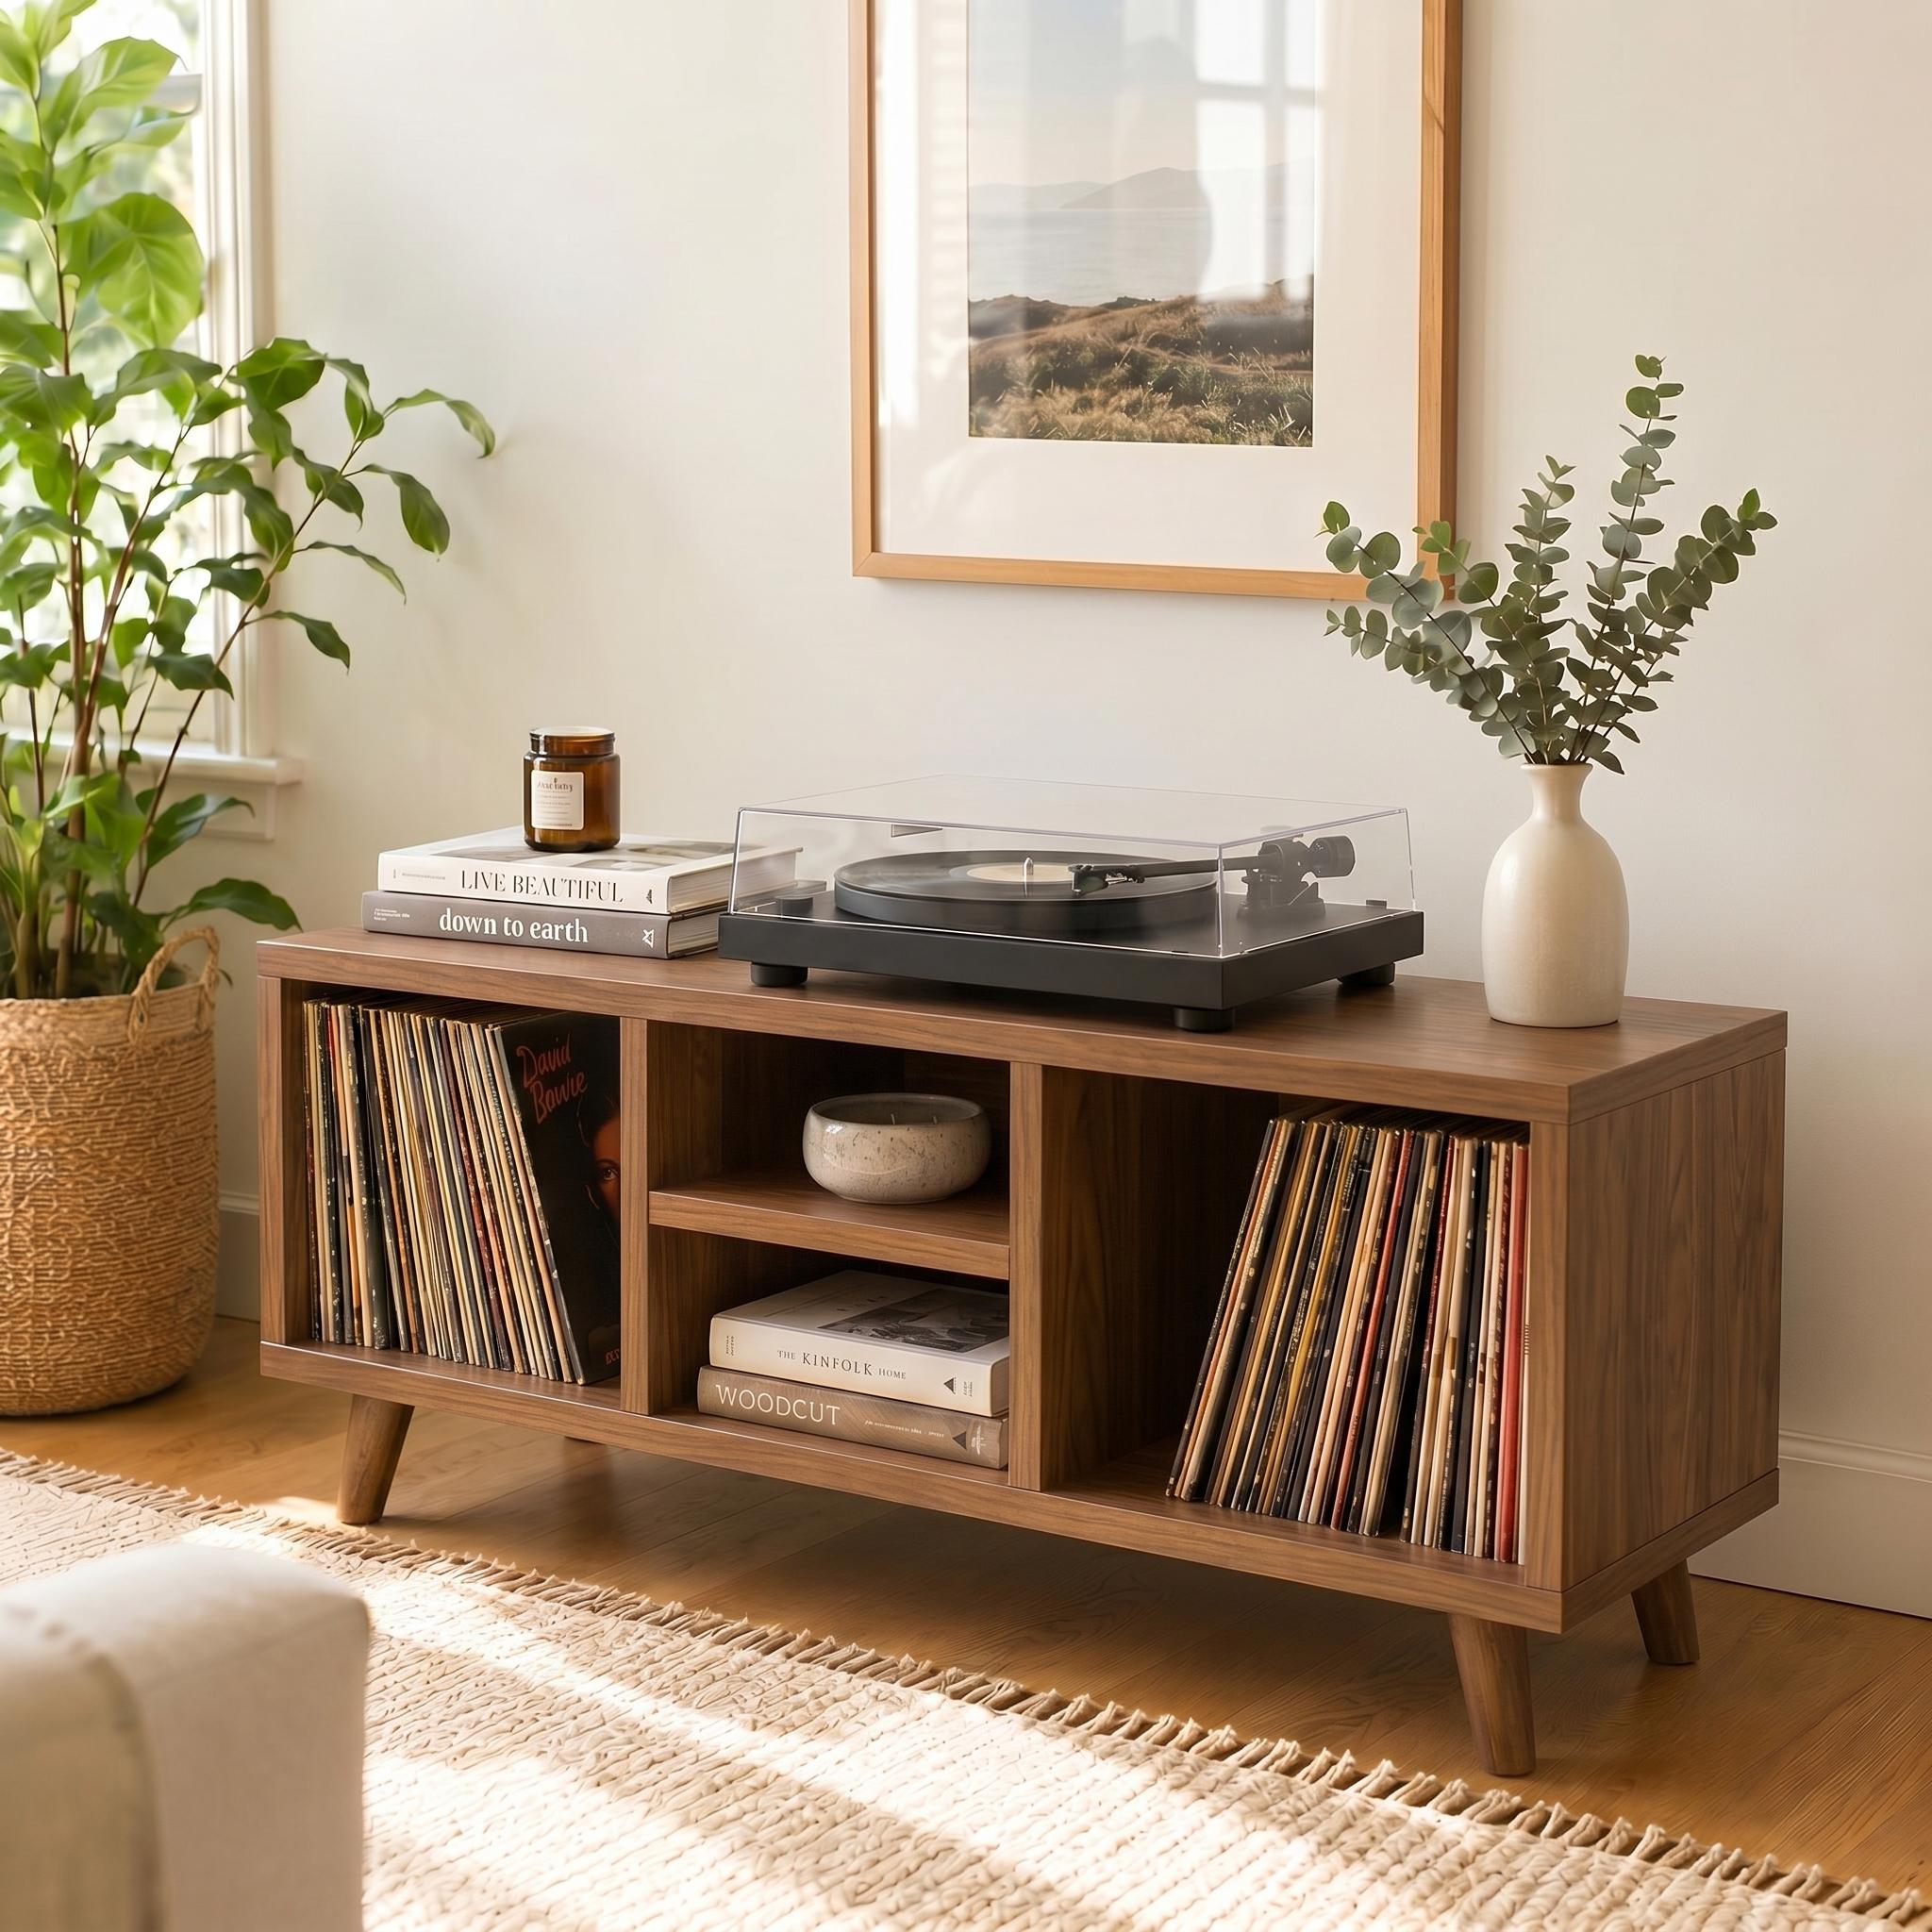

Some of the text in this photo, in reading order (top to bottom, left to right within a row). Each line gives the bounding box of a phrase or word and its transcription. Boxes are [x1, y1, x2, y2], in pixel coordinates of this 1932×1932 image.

[460, 870, 506, 891] LIVE
[513, 875, 624, 903] BEAUTIFUL
[439, 908, 497, 935] down
[504, 916, 524, 937] to
[529, 918, 589, 942] earth
[516, 1032, 571, 1088] David
[530, 1072, 588, 1124] Bowie
[777, 1350, 907, 1379] THE KINFOLK HOME
[715, 1384, 841, 1425] WOODCUT
